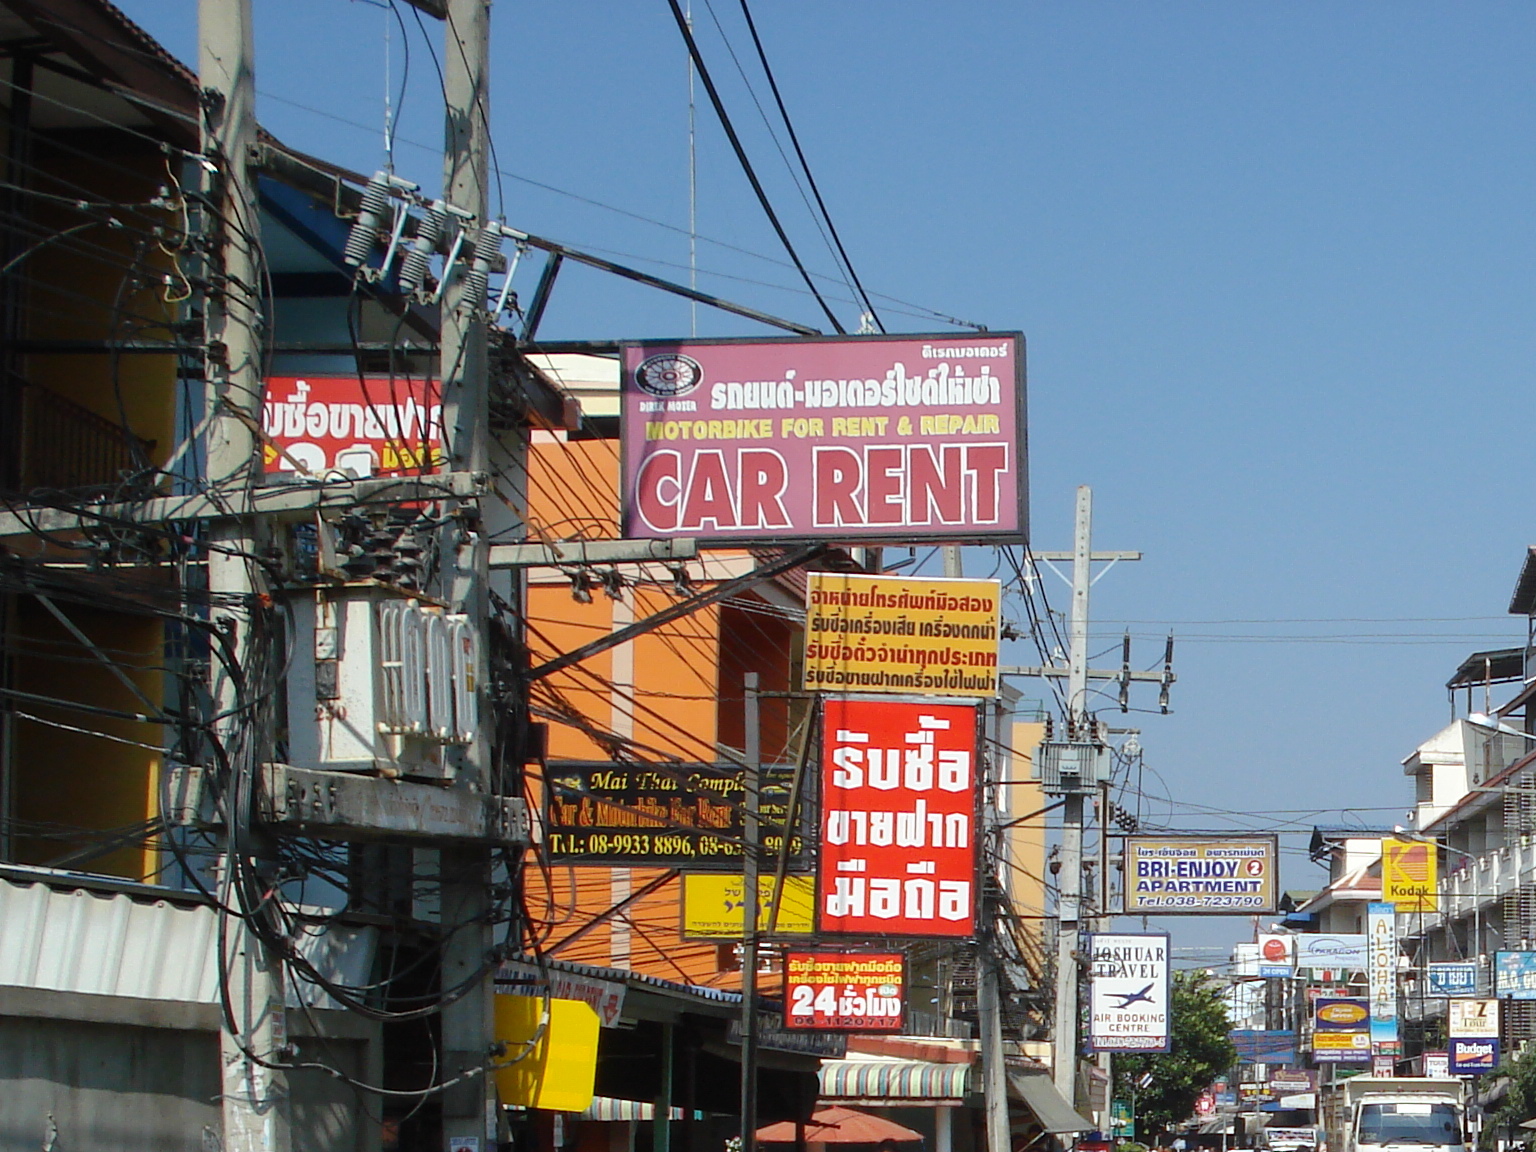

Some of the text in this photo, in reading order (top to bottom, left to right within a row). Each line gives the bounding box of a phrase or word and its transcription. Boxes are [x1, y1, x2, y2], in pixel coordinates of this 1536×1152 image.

[645, 414, 1000, 440] MOTORBIKE FOR RENT & REPAIR
[636, 442, 1009, 532] CAR RENT
[833, 715, 970, 793] รับซื้อ
[590, 772, 628, 790] Mai
[827, 799, 968, 848] ขายฝาก
[1137, 860, 1263, 878] BRI-ENJOY 2
[826, 859, 970, 921] มือถือ
[1136, 880, 1262, 893] APARTMENT
[1390, 884, 1429, 898] Kodak
[1095, 946, 1164, 962] JOSHUAR
[1376, 918, 1389, 1001] ALOHA
[1097, 964, 1159, 979] TRAVEL
[1094, 1013, 1165, 1023] AIR BOOKING
[1108, 1024, 1150, 1032] CENTRE
[1455, 1042, 1494, 1057] Budget
